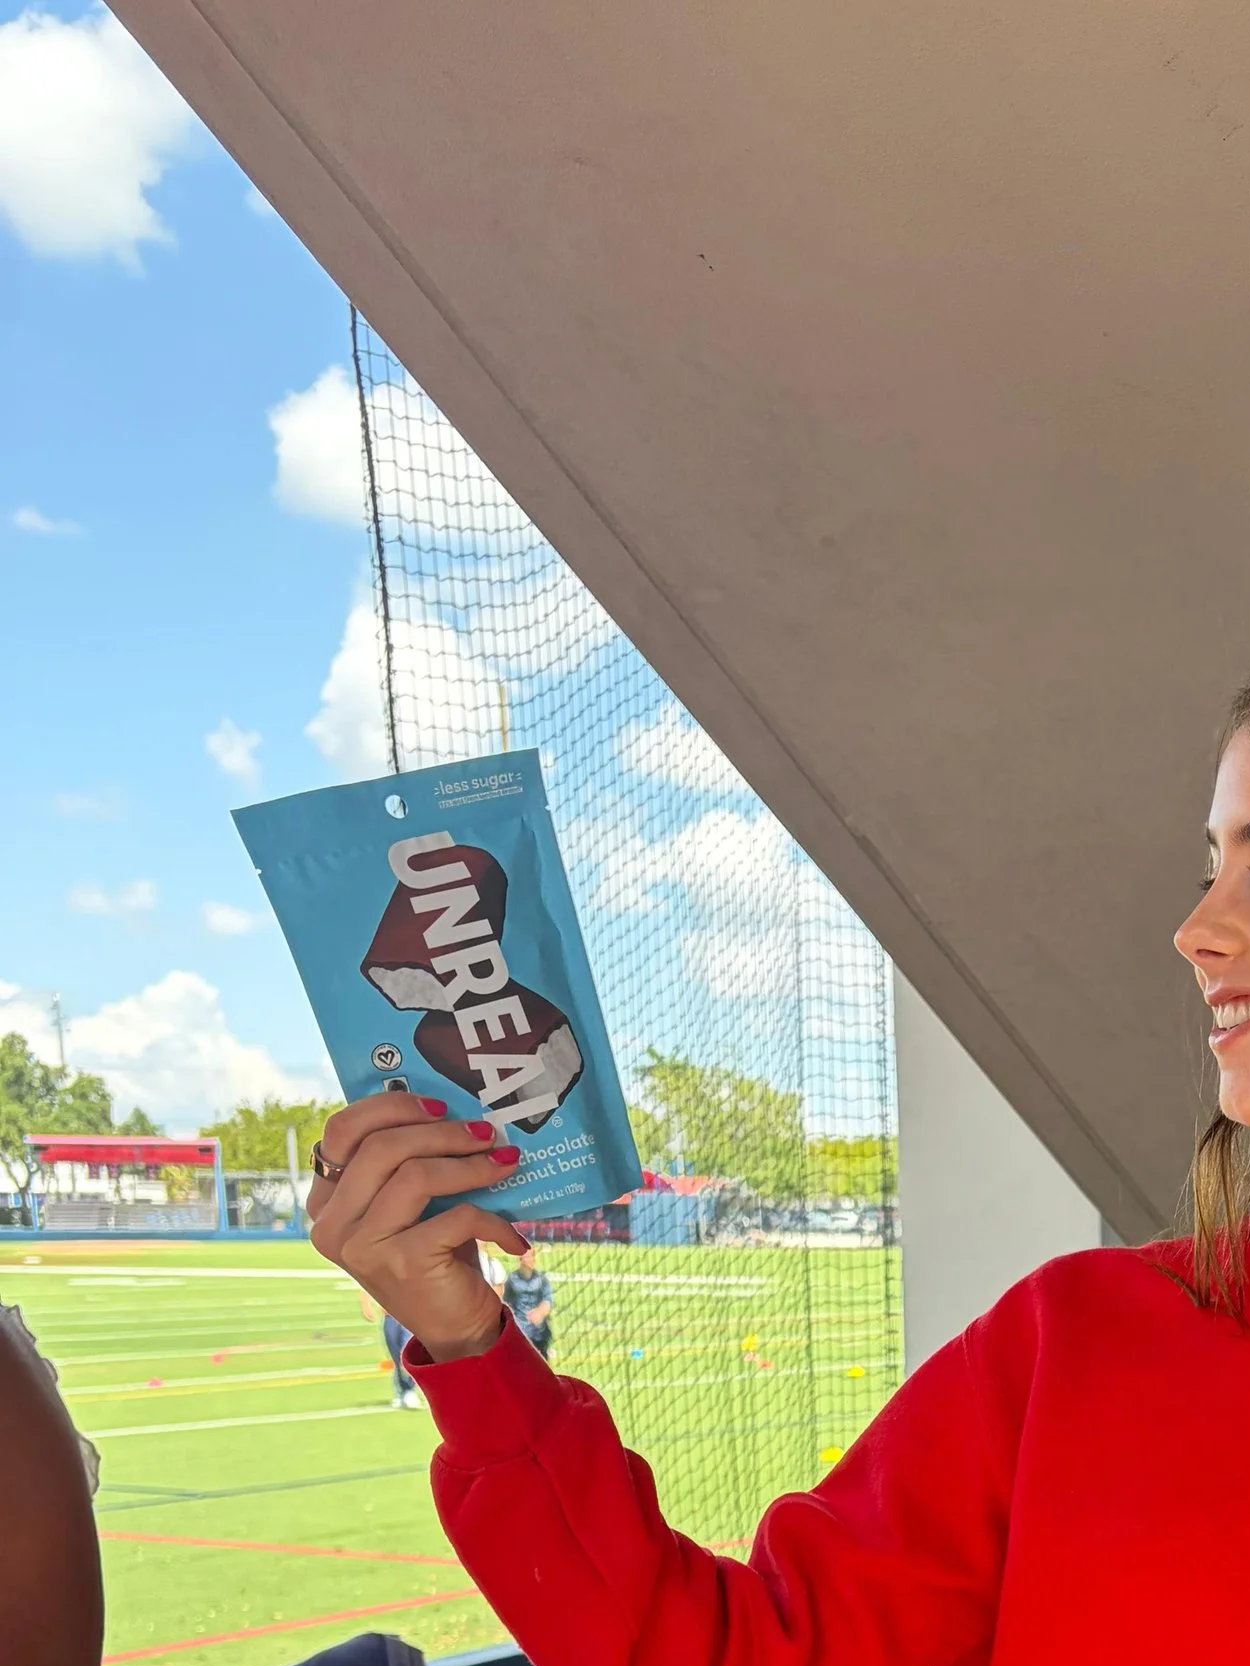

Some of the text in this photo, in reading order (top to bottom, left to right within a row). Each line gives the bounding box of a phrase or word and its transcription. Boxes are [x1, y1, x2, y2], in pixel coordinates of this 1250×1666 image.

[438, 772, 514, 796] less sugar
[387, 830, 559, 1147] UNREAL
[518, 1132, 595, 1167] chocolate
[557, 1153, 596, 1173] bars
